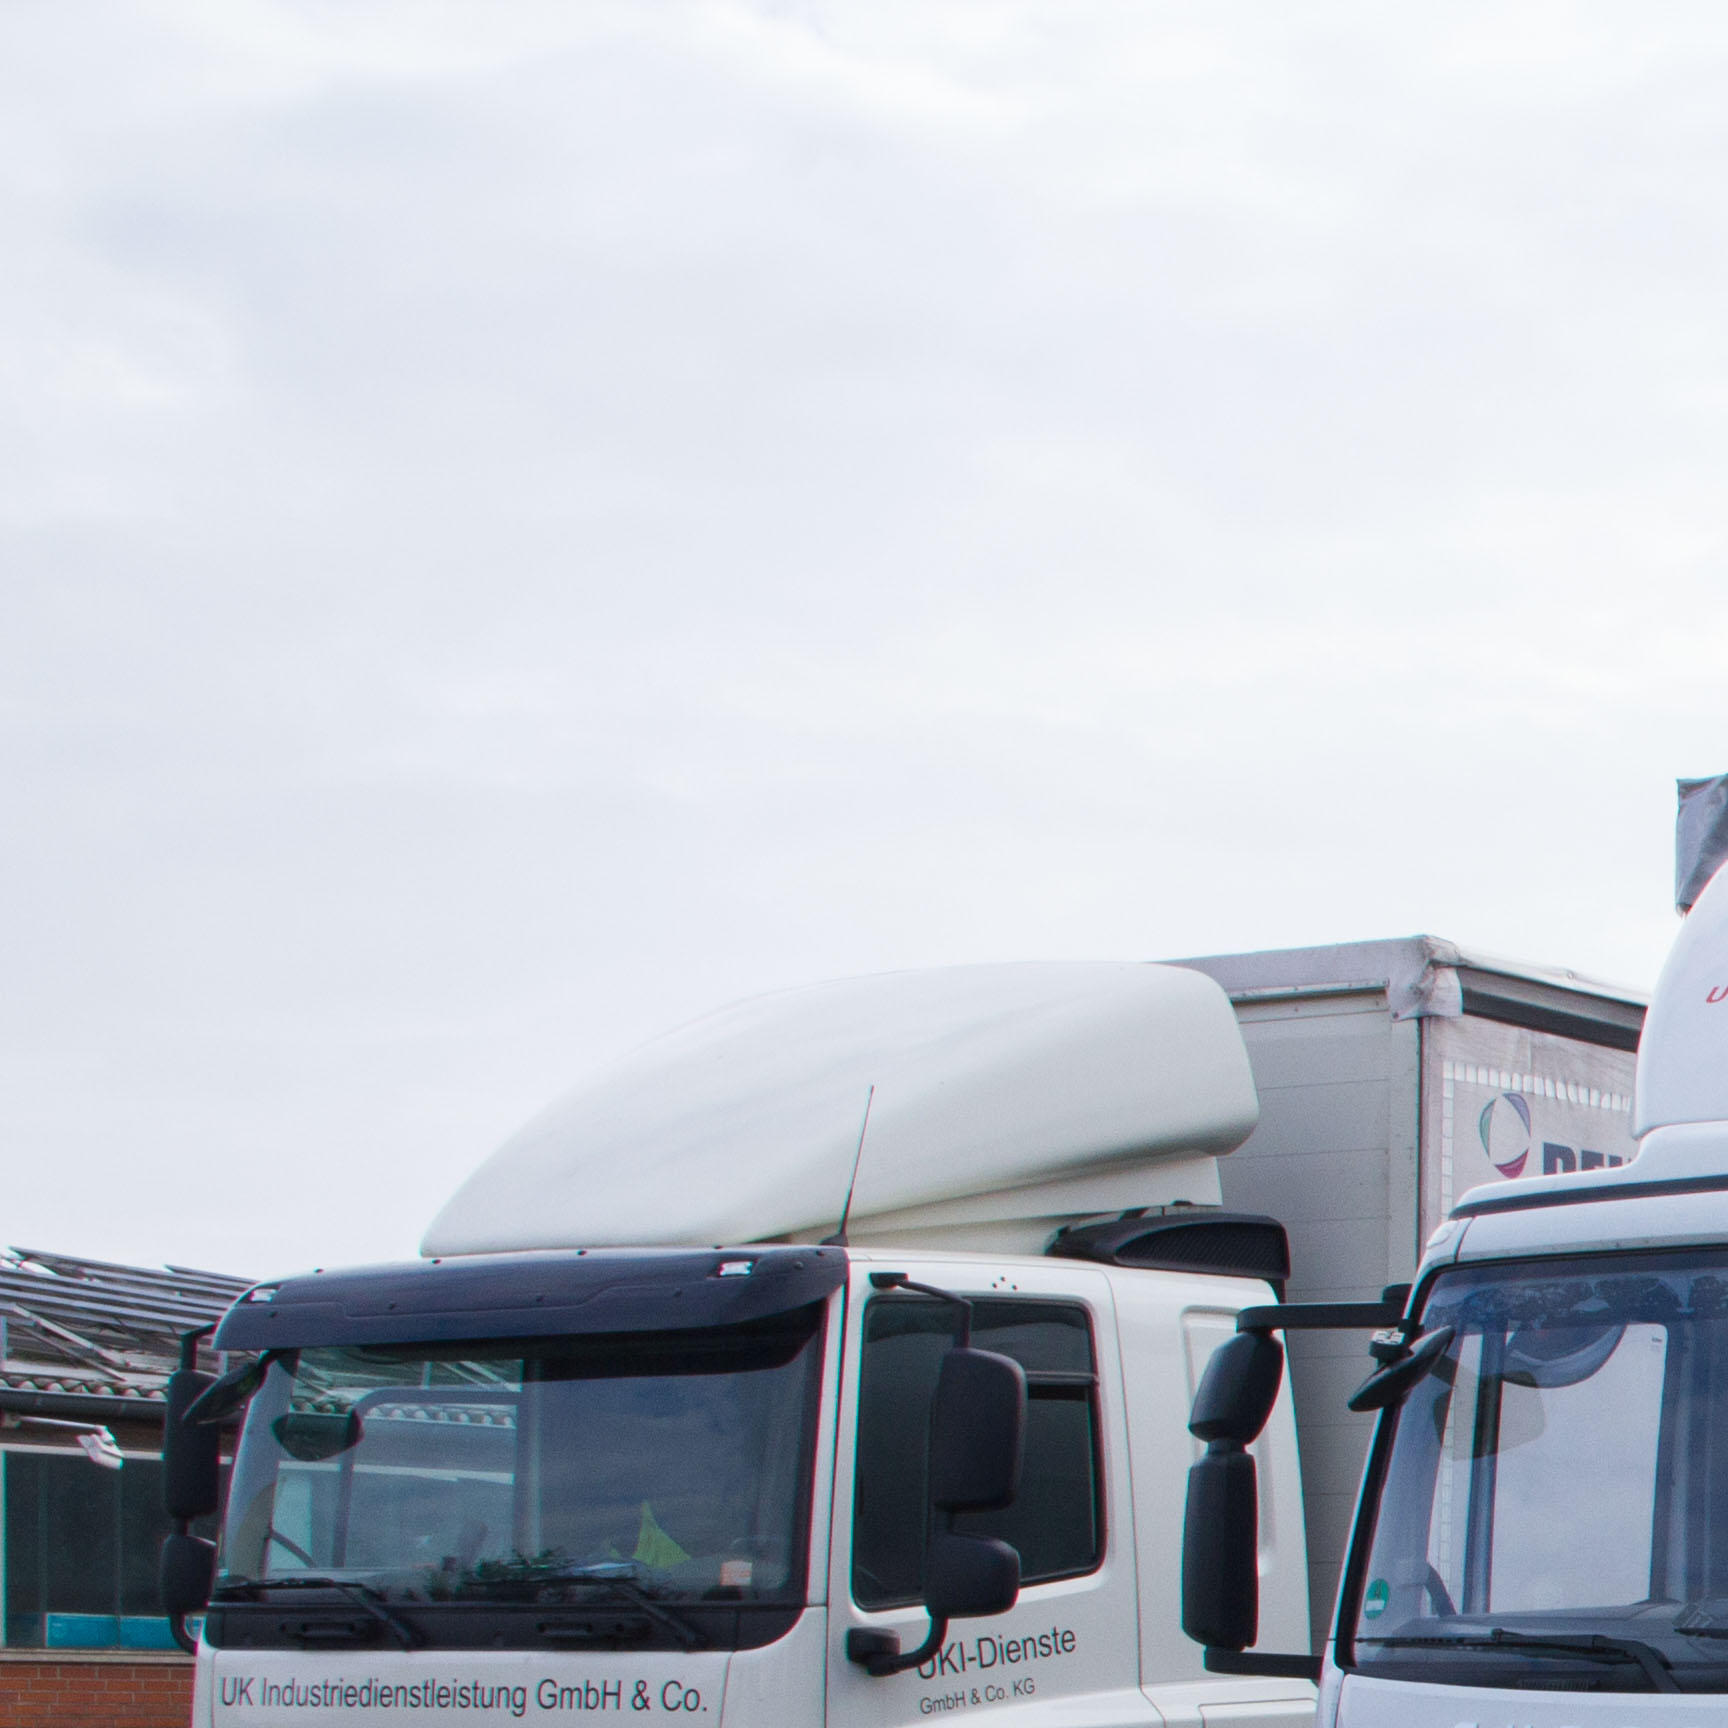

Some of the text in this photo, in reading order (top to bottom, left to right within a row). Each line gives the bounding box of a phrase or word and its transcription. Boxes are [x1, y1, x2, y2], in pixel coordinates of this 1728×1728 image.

[219, 1676, 708, 1717] UK Industriedienstleistung GmbH & Co.
[920, 1677, 1036, 1715] GmbH & Co. KG
